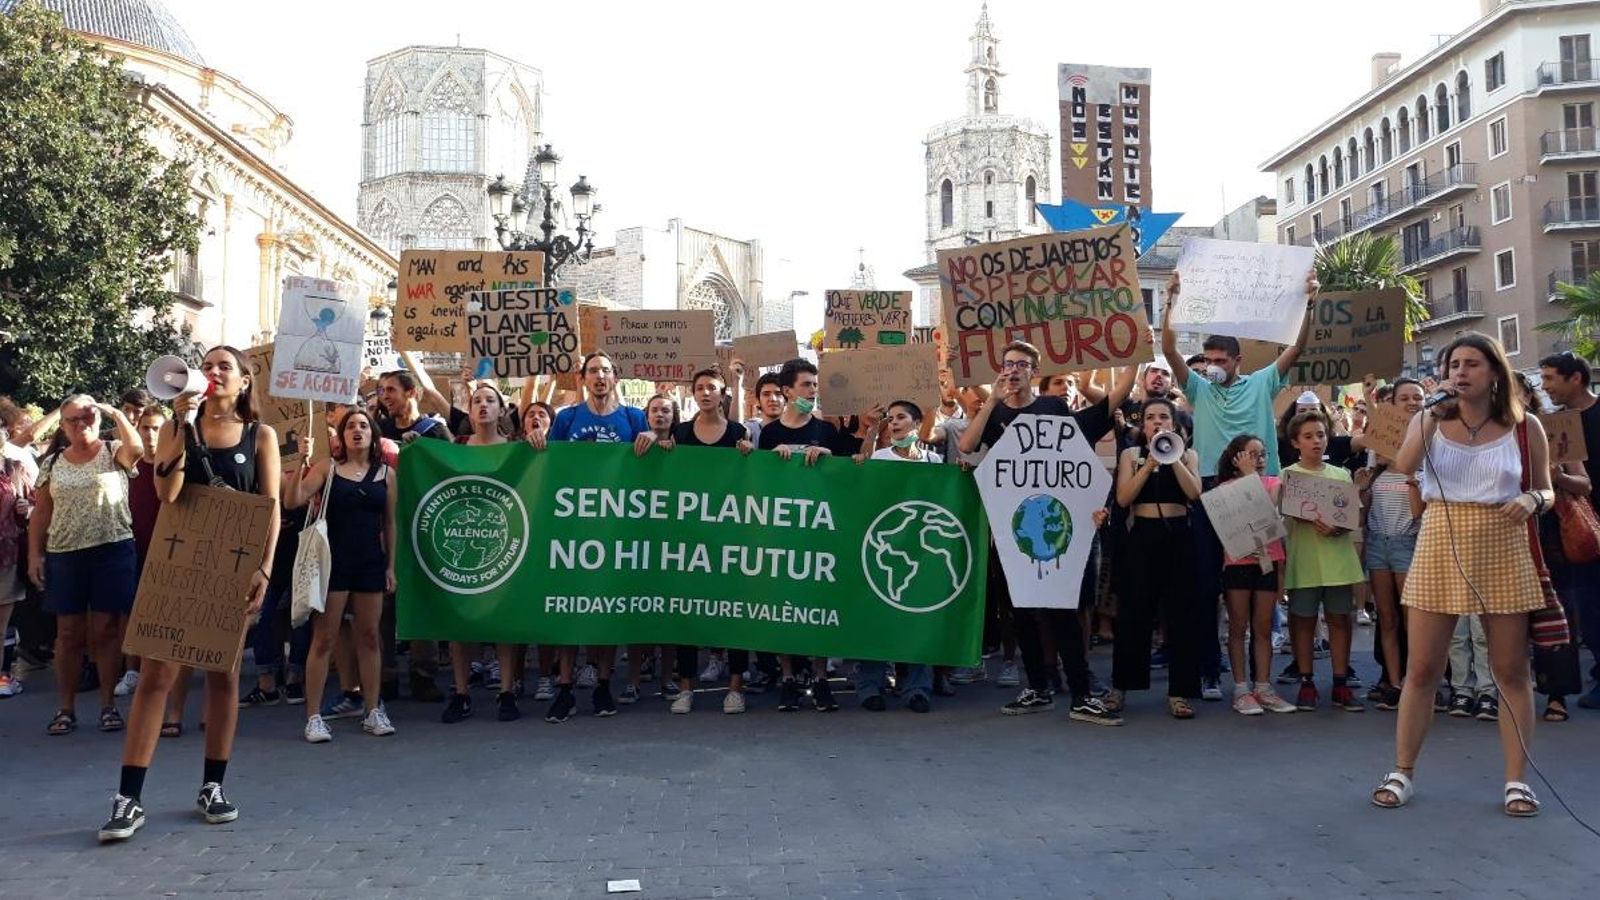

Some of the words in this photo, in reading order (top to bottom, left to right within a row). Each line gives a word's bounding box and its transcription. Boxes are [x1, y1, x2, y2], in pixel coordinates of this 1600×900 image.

[1072, 86, 1087, 138] NOS
[408, 258, 437, 276] MAN
[457, 254, 484, 274] and
[502, 253, 530, 275] his
[948, 256, 978, 283] NO
[980, 250, 1005, 277] OS
[1010, 234, 1122, 272] DEJAREMOS
[407, 282, 437, 300] WAR
[951, 257, 1131, 308] ESPECULAR
[404, 306, 418, 319] is
[431, 304, 466, 318] inevit
[857, 290, 905, 314] VERDE
[956, 300, 1017, 331] CON
[1023, 286, 1134, 322] NUESTRO
[1366, 306, 1386, 322] LA
[406, 322, 457, 343] against
[468, 311, 571, 336] PLANETA
[1315, 328, 1333, 341] EN
[606, 335, 653, 346] ESTUDIANDO
[671, 335, 682, 345] UN
[958, 313, 1139, 379] FUTURO
[275, 370, 298, 388] SE
[1294, 358, 1351, 383] TODO
[1012, 419, 1076, 455] DEP
[995, 458, 1093, 489] FUTURO
[419, 486, 459, 533] JUVENTUD
[460, 486, 468, 494] X
[471, 486, 483, 495] EL
[486, 487, 514, 512] CLIMA
[554, 487, 670, 519] SENSE
[676, 492, 836, 531] PLANETA
[443, 526, 501, 540] VALÈNCIA
[192, 539, 224, 571] EN
[438, 566, 479, 585] FRIDAYS
[480, 568, 500, 583] FOR
[497, 537, 521, 570] FUTURE
[549, 539, 606, 571] NO
[613, 540, 651, 571] HI
[661, 541, 713, 574] HA
[721, 545, 836, 583] FUTUR
[144, 560, 240, 602] NUESTROS
[136, 591, 246, 633] CORAZONES
[544, 595, 627, 614] FRIDAYS
[630, 596, 665, 614] FOR
[669, 597, 744, 619] FUTURE
[747, 600, 840, 627] VALÈNCIA
[136, 622, 186, 644] NUESTRO
[171, 643, 223, 664] FUTURO
